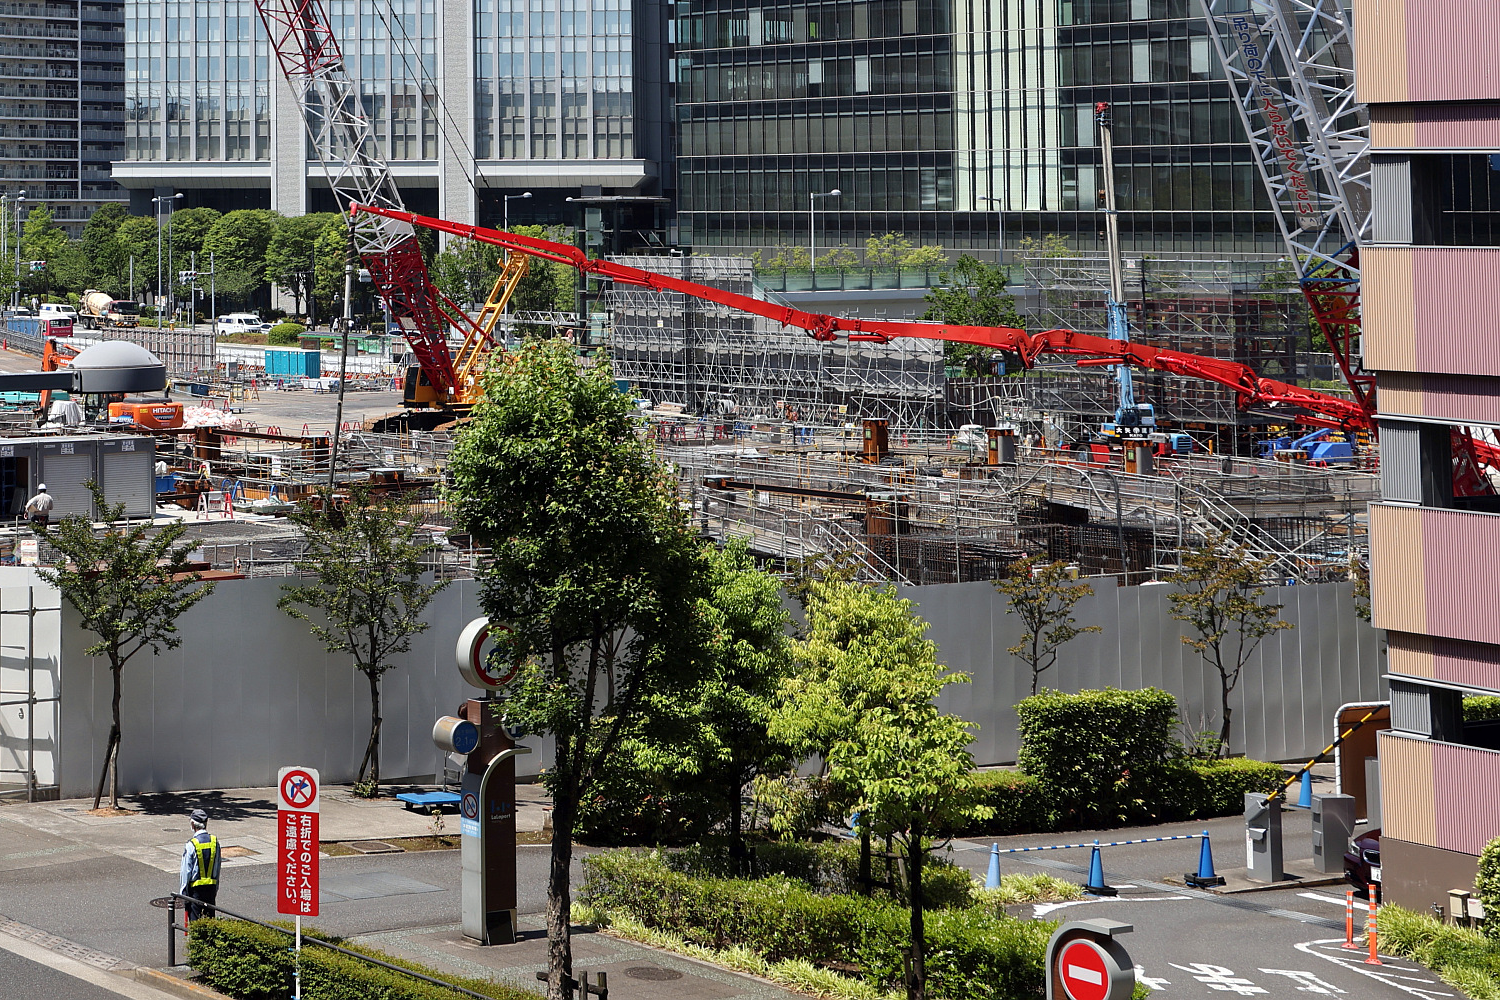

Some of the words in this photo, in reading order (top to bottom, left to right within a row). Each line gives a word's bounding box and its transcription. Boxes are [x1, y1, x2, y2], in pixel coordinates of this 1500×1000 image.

[1232, 16, 1314, 215] 吊り荷の下に入らないでください
[285, 813, 297, 905] ご遠慮ください。
[299, 814, 312, 913] 右折でのご入場は
